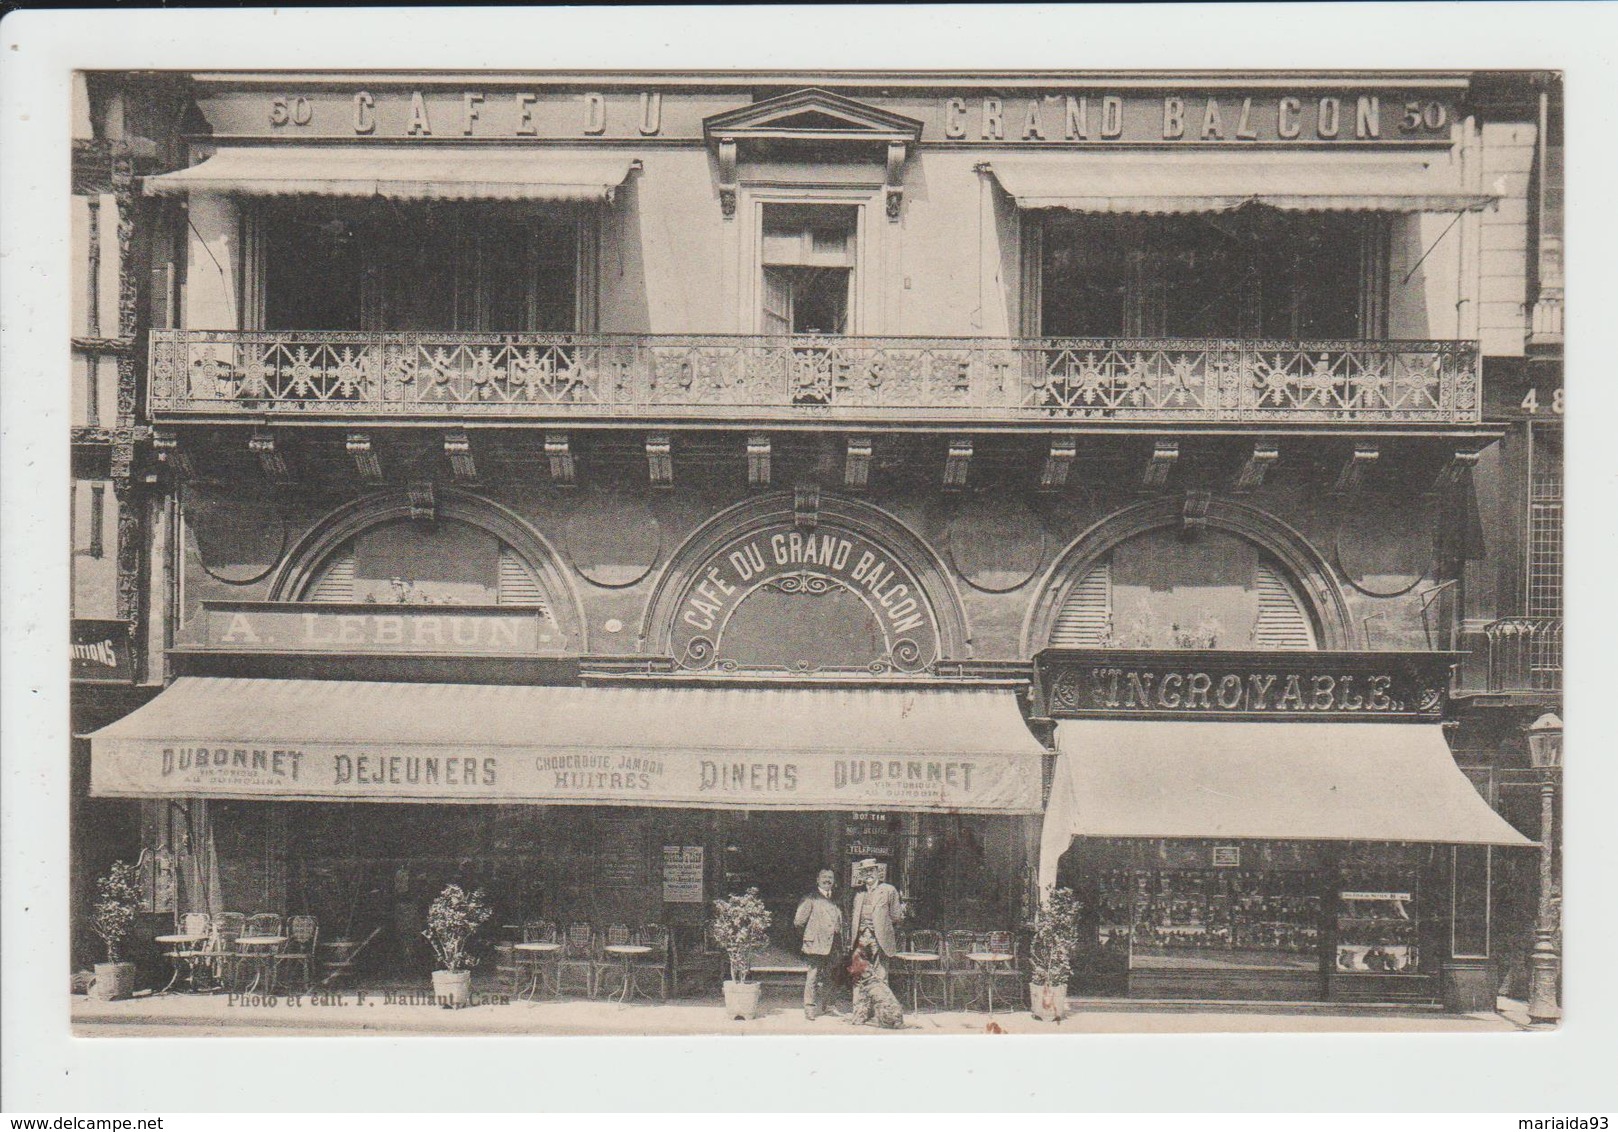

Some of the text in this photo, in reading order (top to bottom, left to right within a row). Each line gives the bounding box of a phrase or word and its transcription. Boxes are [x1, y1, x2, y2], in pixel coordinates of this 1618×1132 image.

[268, 97, 313, 126] 50
[583, 92, 662, 135] DU
[944, 95, 1124, 141] GRAND
[1162, 96, 1381, 142] BALCON
[1400, 101, 1447, 133] 50
[1521, 388, 1565, 414] 48
[729, 542, 766, 581] DU
[771, 532, 852, 571] GRAND
[851, 550, 924, 634] BALCON
[221, 612, 526, 646] A. LEBRUN
[162, 748, 303, 781] DUBONNET
[834, 760, 976, 792] DUBONNET
